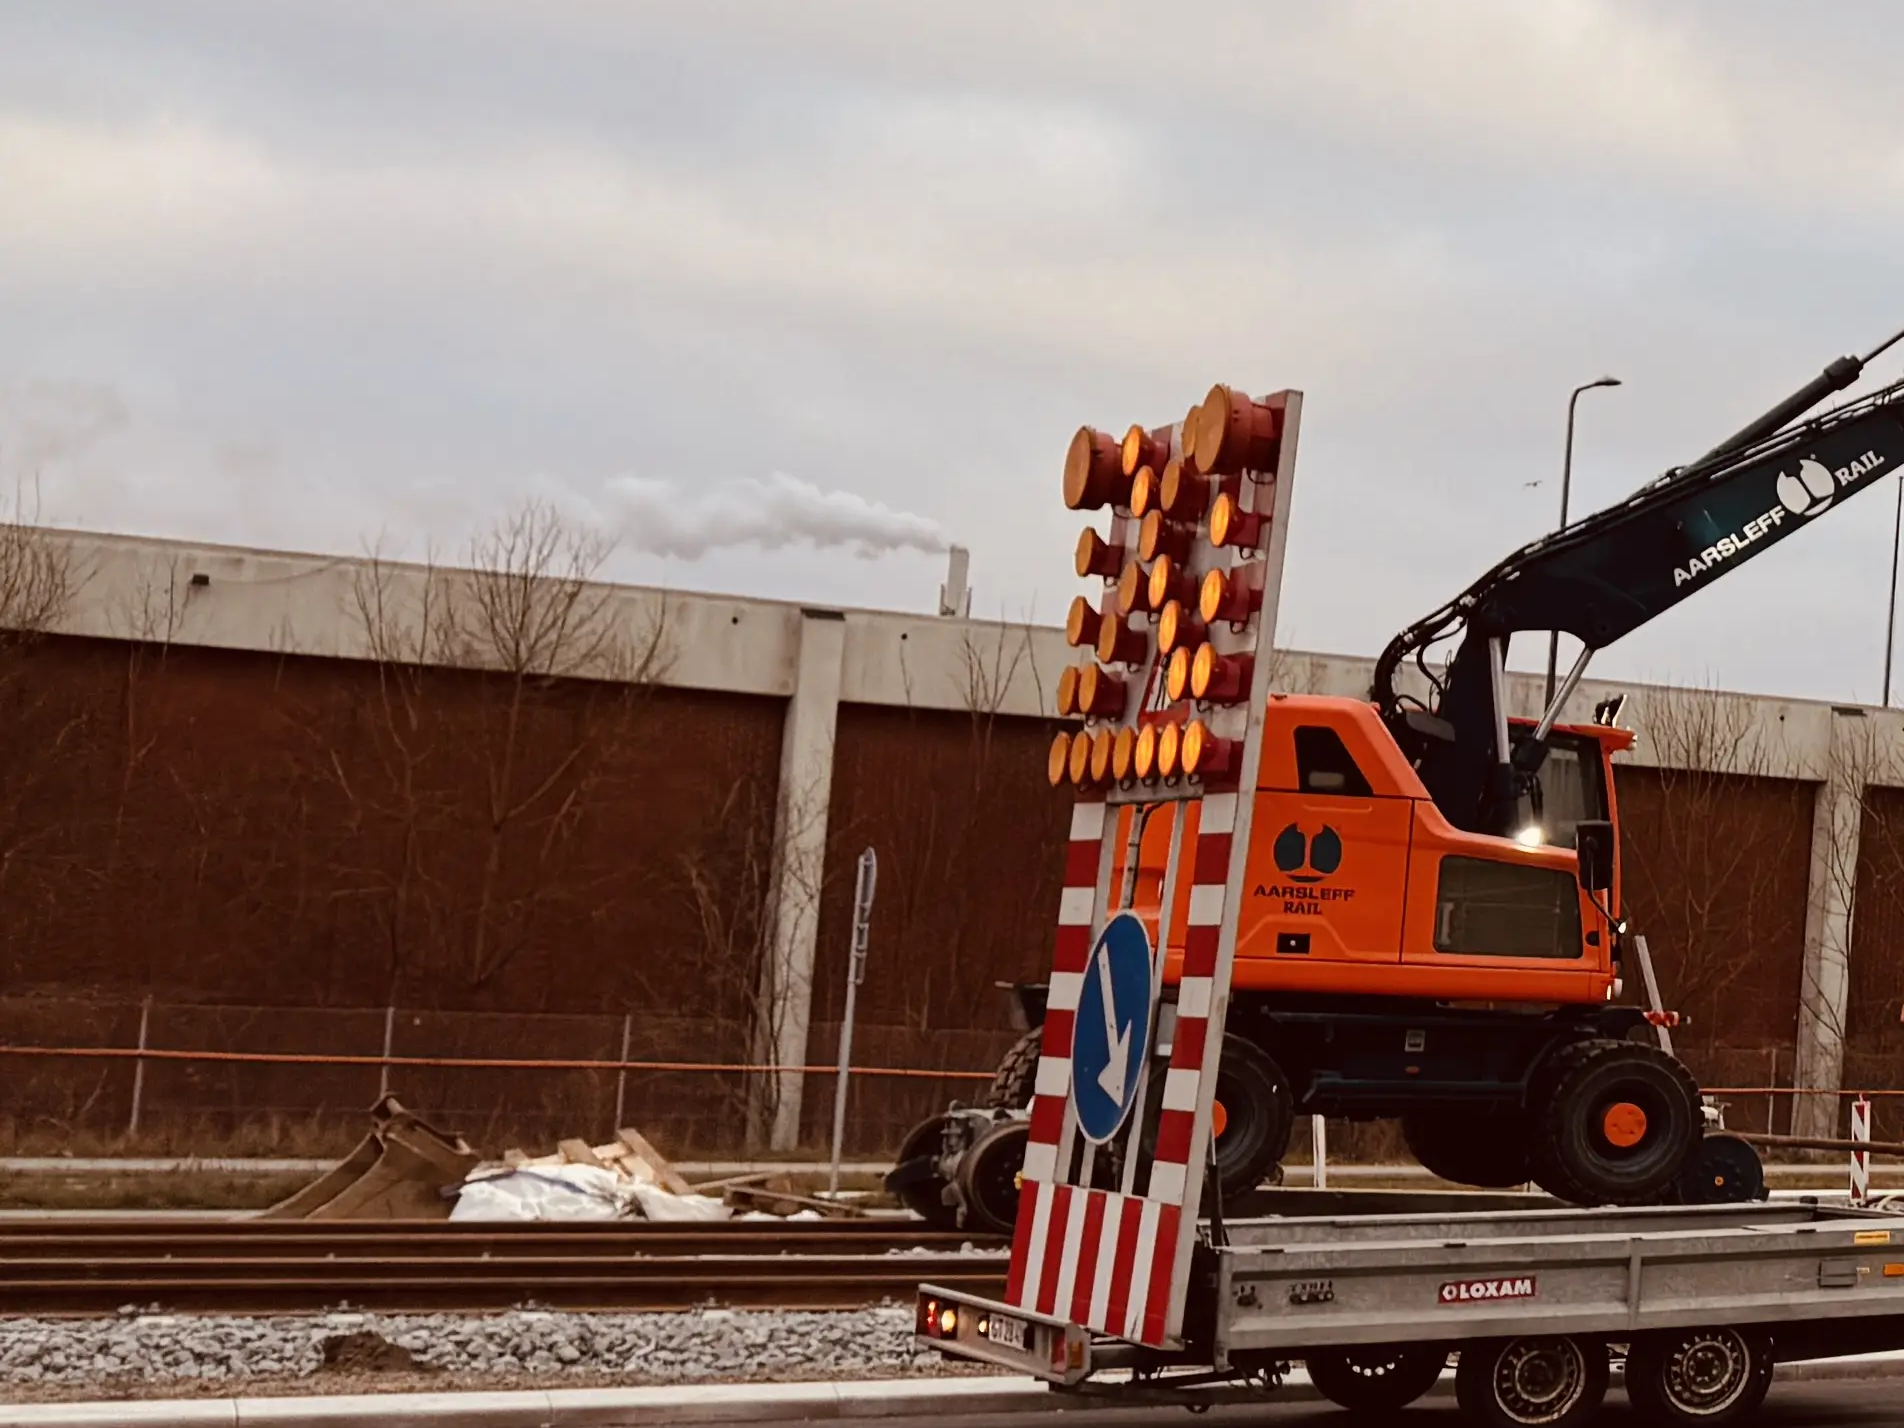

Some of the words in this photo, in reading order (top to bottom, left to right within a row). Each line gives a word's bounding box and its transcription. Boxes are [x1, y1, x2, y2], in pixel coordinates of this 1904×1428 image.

[1673, 505, 1786, 587] AARSLEFF
[1834, 450, 1885, 486] RAIL
[1253, 884, 1355, 902] AARSLEFF
[1283, 901, 1323, 915] RAIL
[1459, 1279, 1533, 1299] LOXAM
